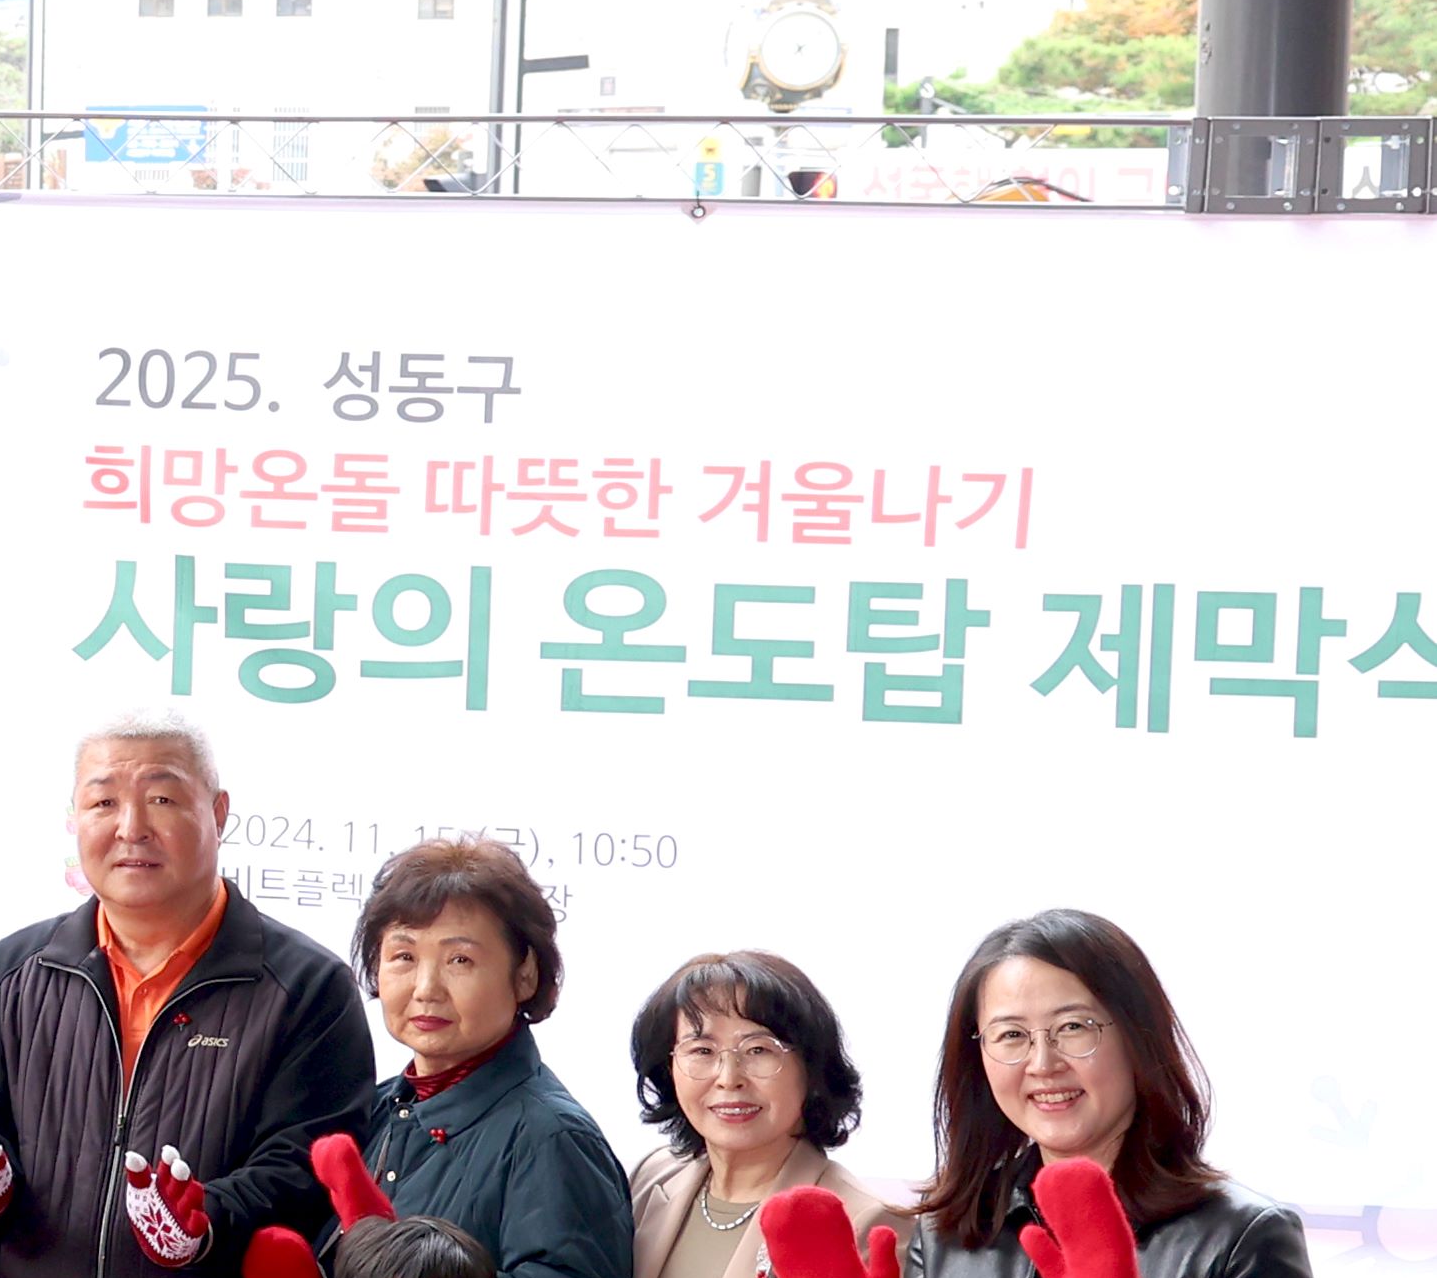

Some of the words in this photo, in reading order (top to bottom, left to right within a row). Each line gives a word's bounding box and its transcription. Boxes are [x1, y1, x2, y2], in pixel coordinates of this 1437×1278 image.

[94, 345, 283, 413] 2025.
[322, 348, 524, 424] 성동구
[82, 443, 400, 538] 희망온돌
[424, 455, 673, 543] 따뜻한
[698, 460, 1037, 550] 겨울나기
[71, 552, 492, 714] 사랑의
[538, 567, 990, 726] 온도탑
[222, 812, 325, 852] 2024.
[572, 830, 679, 870] 10:50
